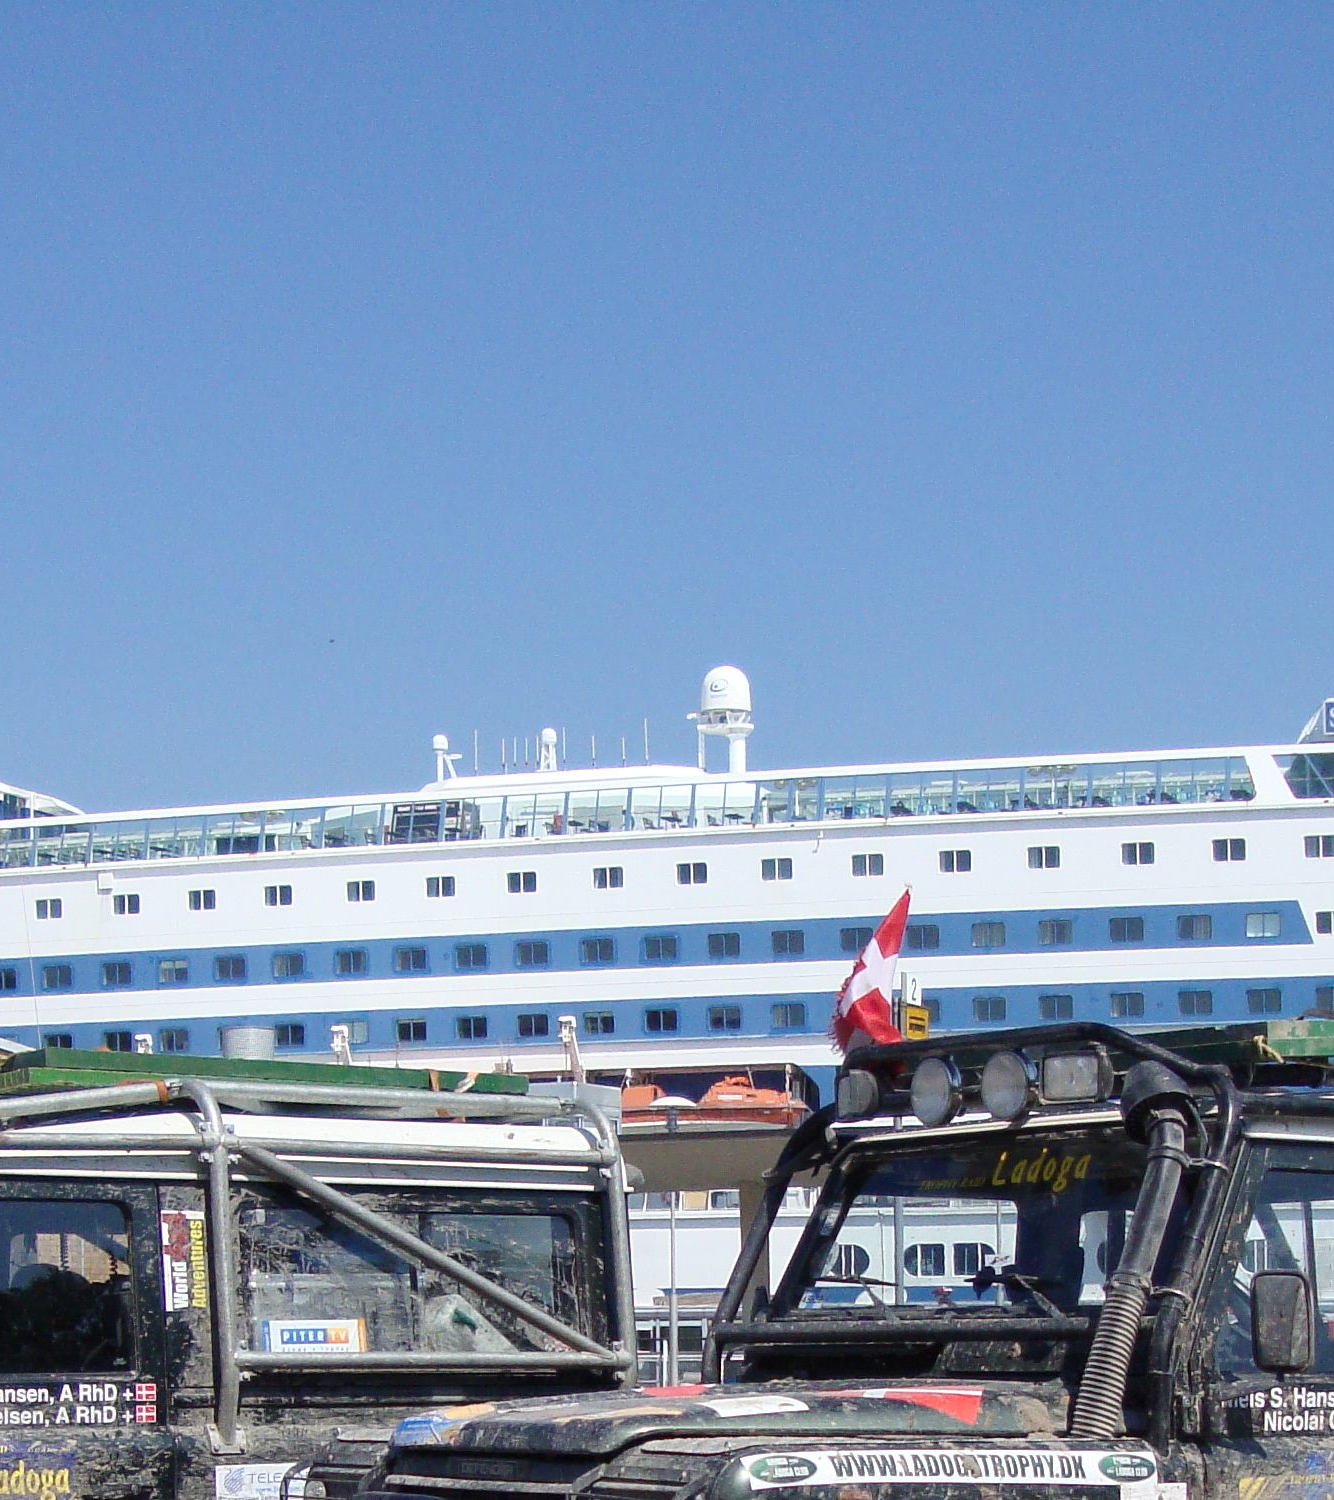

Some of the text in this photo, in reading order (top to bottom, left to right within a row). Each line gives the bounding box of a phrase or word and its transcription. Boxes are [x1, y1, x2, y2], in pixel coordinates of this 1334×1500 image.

[911, 977, 917, 1001] 2
[992, 1147, 1092, 1192] Ladoga
[189, 1220, 207, 1308] Adventures
[172, 1261, 189, 1309] World
[283, 1330, 347, 1342] PITER TV
[59, 1384, 74, 1402] A
[78, 1383, 118, 1402] RhD
[1270, 1386, 1288, 1409] S.
[55, 1406, 70, 1424] A
[76, 1405, 117, 1424] RhD
[1263, 1409, 1324, 1431] Nicolai
